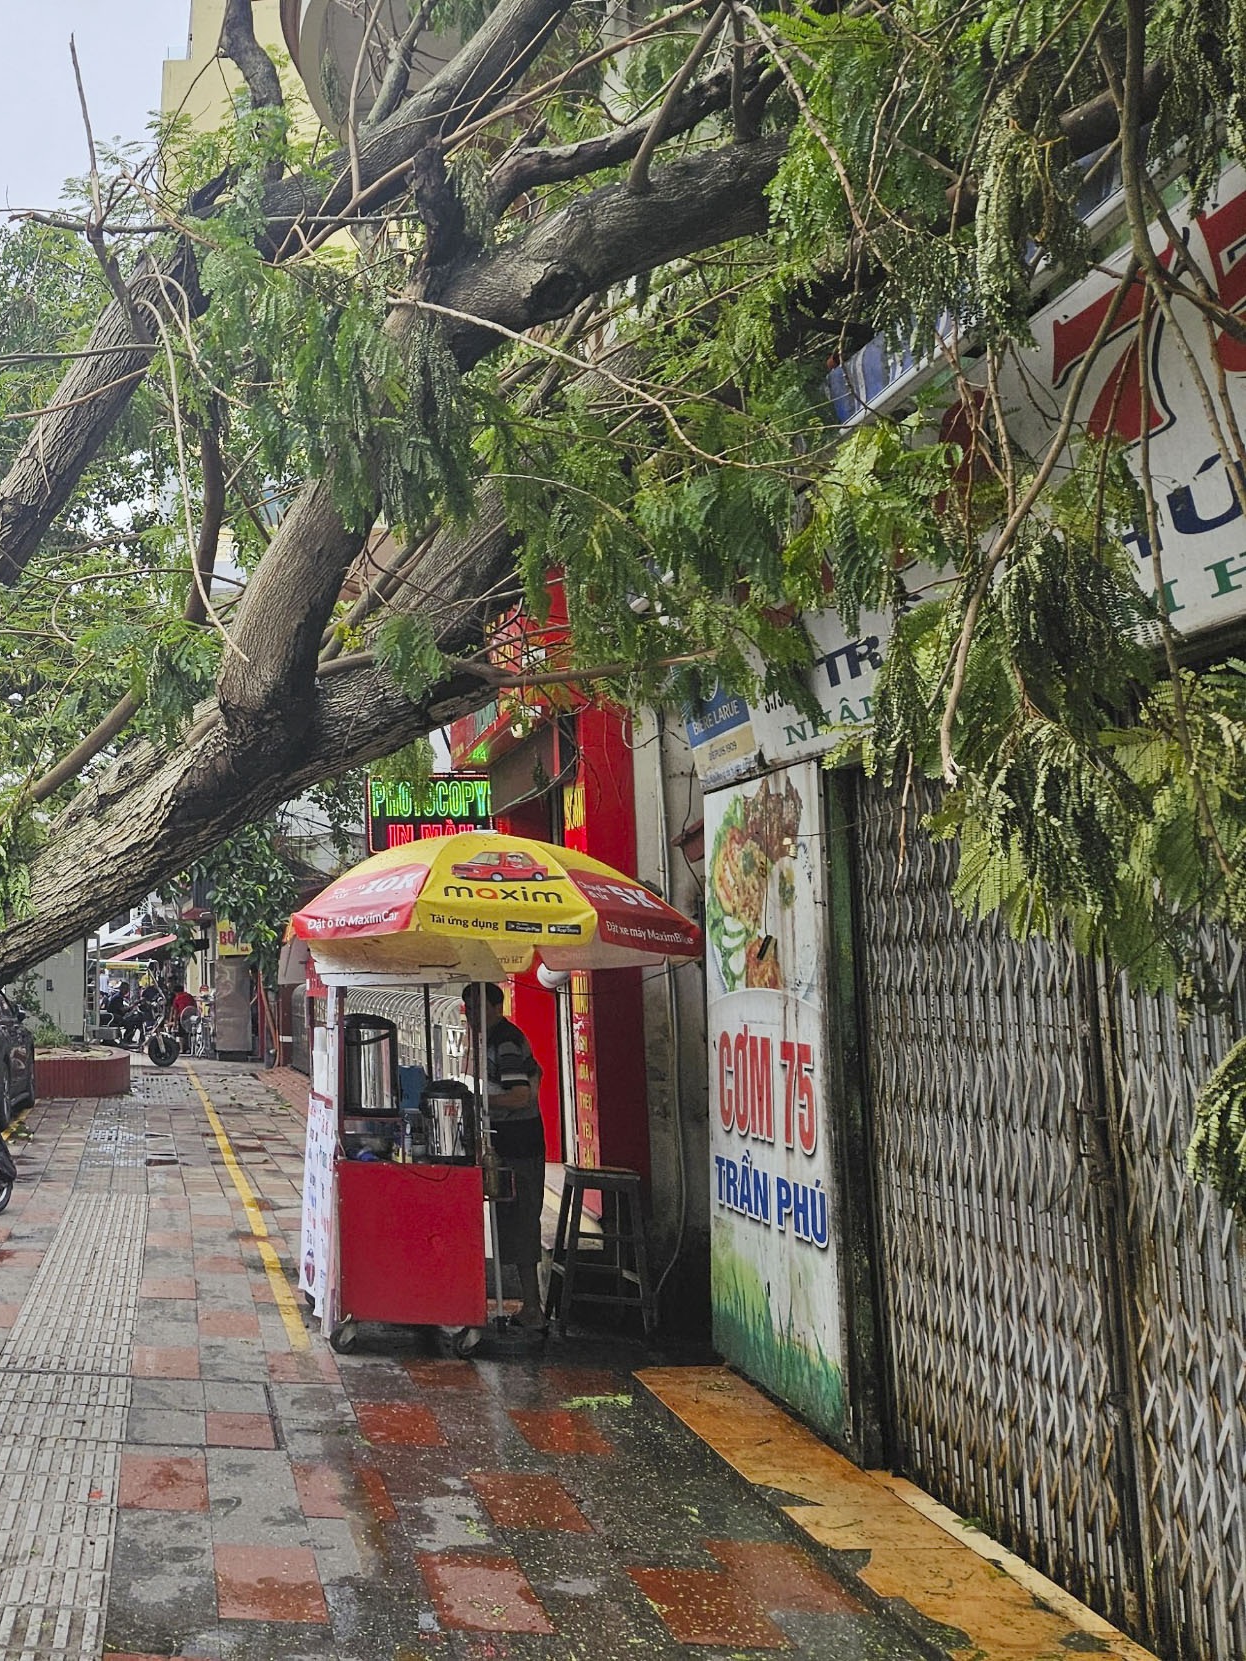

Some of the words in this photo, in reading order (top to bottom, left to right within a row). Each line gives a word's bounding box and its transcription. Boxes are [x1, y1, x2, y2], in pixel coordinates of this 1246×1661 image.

[713, 700, 740, 725] LARUE
[388, 824, 414, 848] IN
[360, 871, 425, 895] 10K
[444, 885, 563, 904] maxim
[605, 884, 664, 910] 5K
[430, 913, 445, 924] Tải
[448, 915, 469, 928] ứng
[472, 917, 499, 930] dụng
[605, 920, 618, 936] Đặt
[620, 927, 628, 935] xe
[629, 926, 646, 940] máy
[648, 929, 694, 945] MaximBe
[719, 1024, 774, 1142] CƠM
[780, 1040, 815, 1154] 75
[715, 1150, 770, 1223] TRẦN
[775, 1176, 828, 1247] PHÚ
